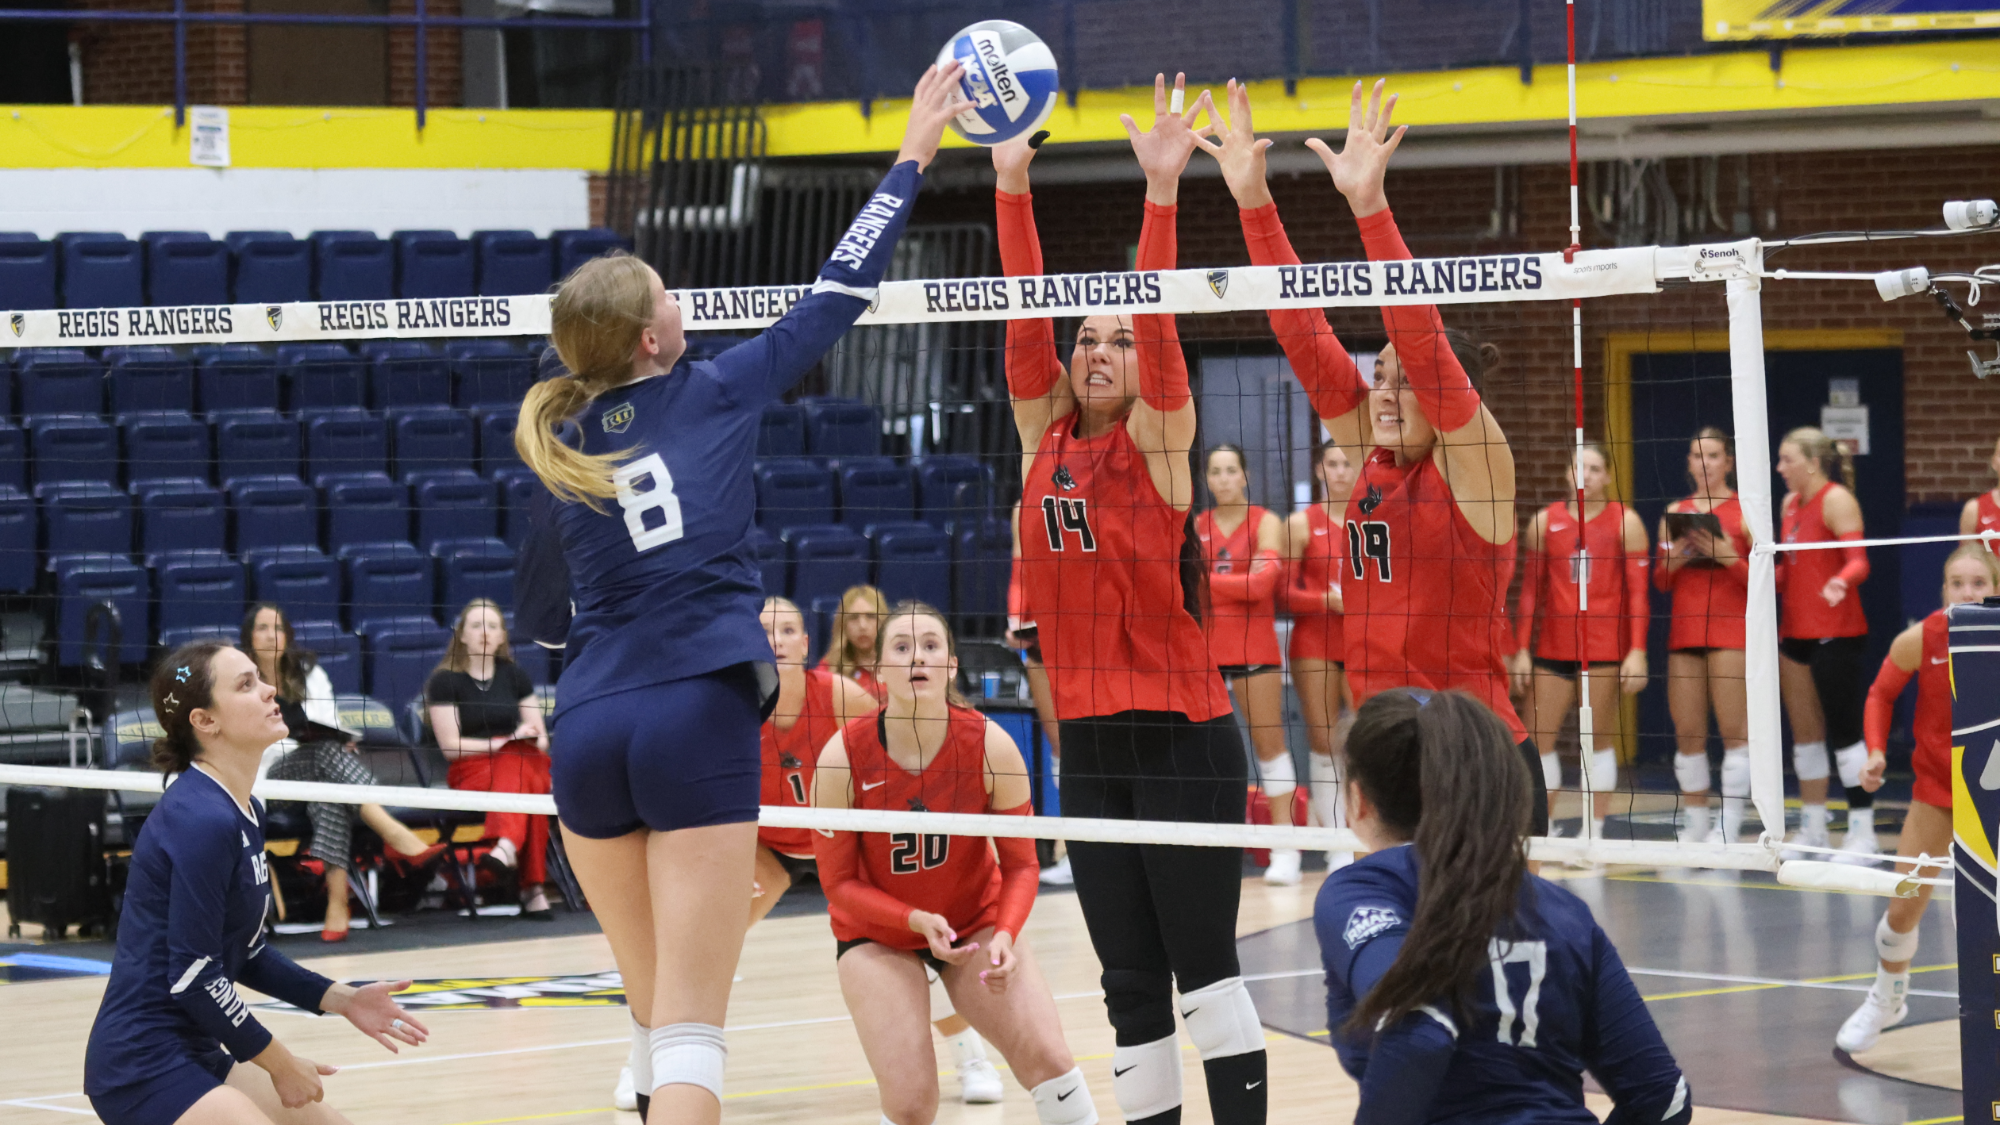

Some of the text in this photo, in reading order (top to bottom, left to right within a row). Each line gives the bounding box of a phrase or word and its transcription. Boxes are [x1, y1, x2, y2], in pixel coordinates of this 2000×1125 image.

[958, 54, 998, 109] NCAA
[977, 39, 1016, 103] molten
[830, 193, 904, 270] RANGERS
[1708, 248, 1739, 259] Senoh
[923, 272, 1161, 313] REGIS RANGERS
[1278, 256, 1542, 299] REGIS RANGERS
[58, 306, 233, 338] REGIS RANGERS
[318, 298, 510, 331] REGIS RANGERS
[691, 288, 811, 321] RANGER
[612, 452, 684, 553] 8
[1041, 494, 1097, 552] 14
[1346, 519, 1392, 583] 19
[787, 772, 807, 804] 1
[890, 832, 950, 875] 20
[1347, 910, 1395, 943] RMAC
[1487, 936, 1547, 1048] 17
